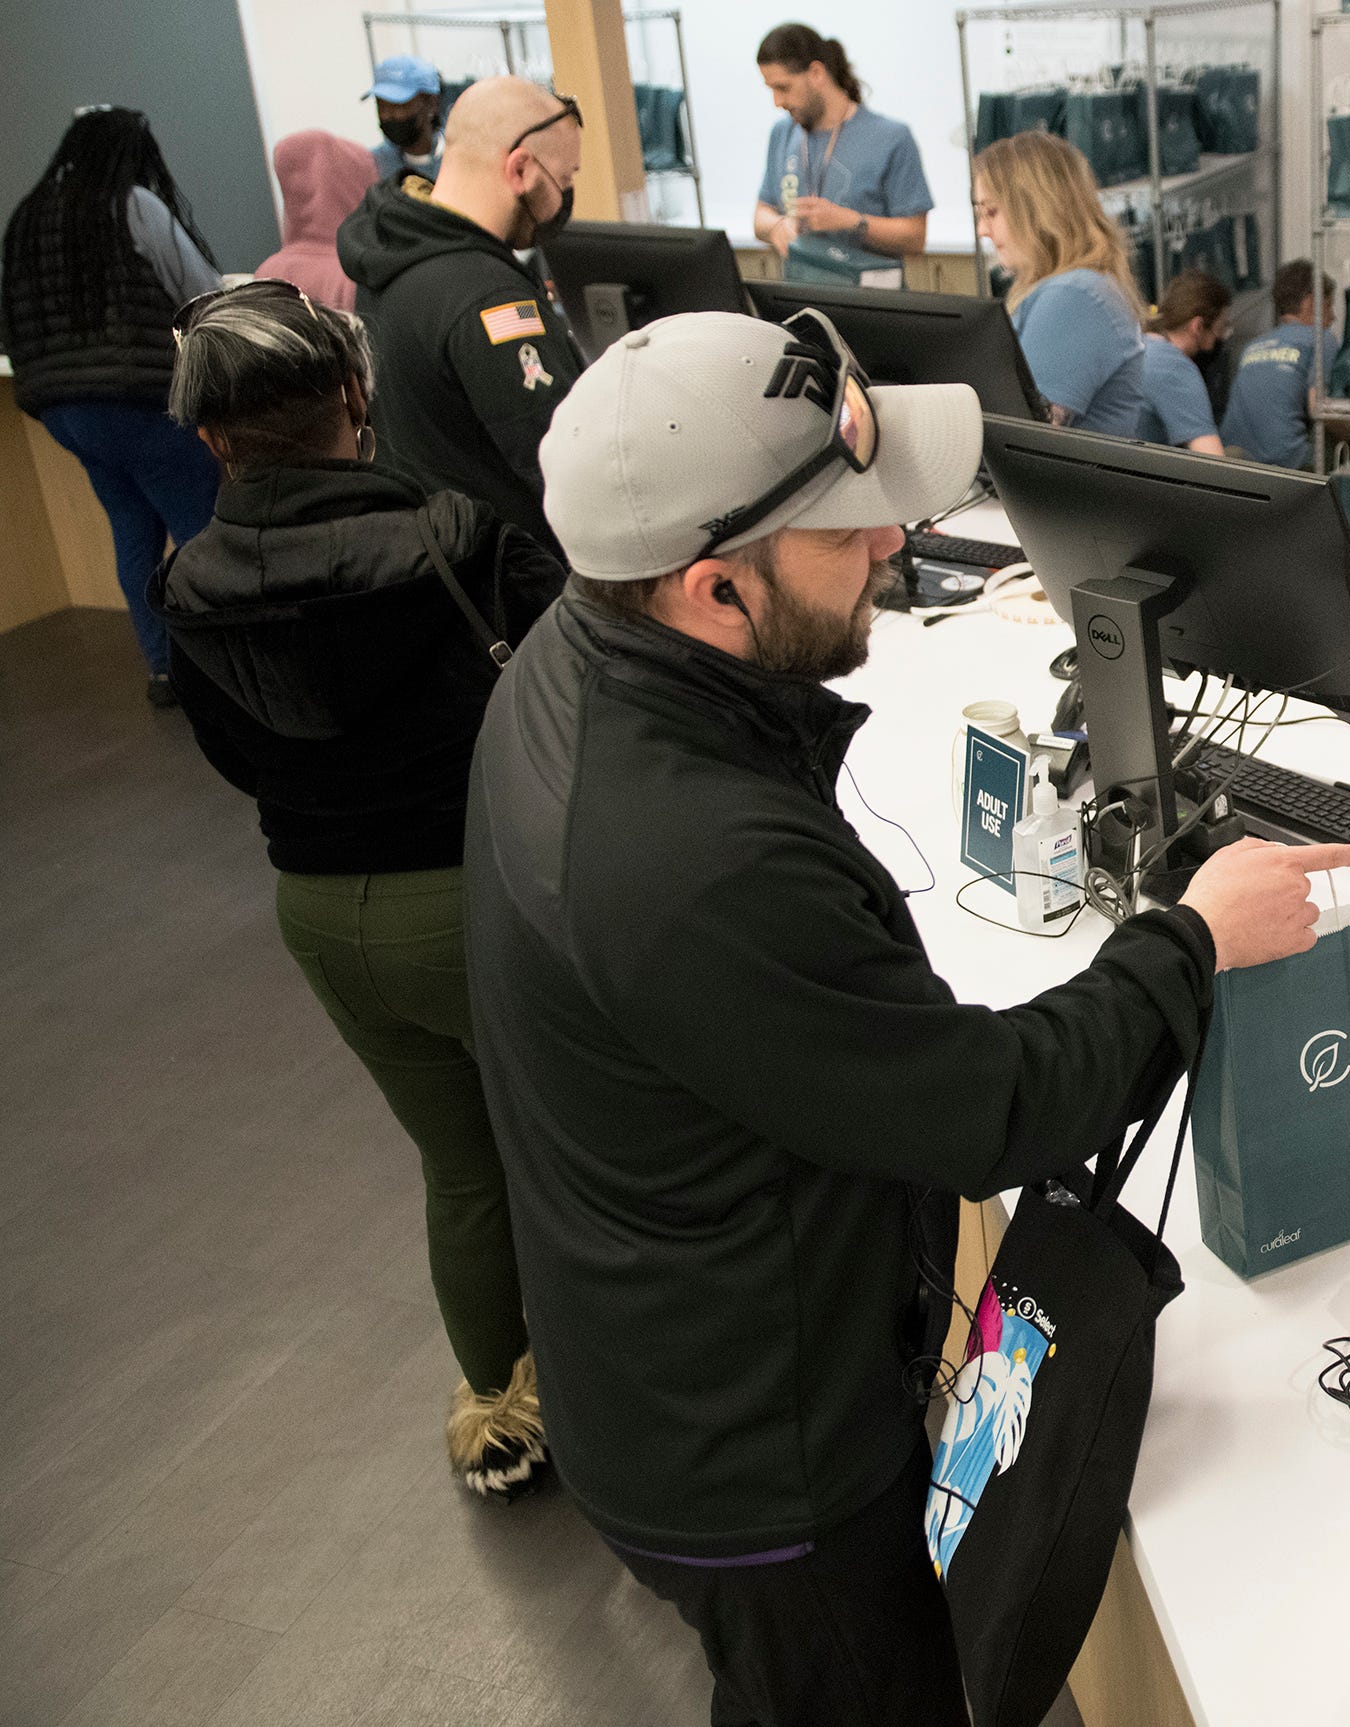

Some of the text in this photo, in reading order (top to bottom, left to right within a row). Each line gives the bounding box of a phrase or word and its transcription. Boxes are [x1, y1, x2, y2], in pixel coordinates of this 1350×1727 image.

[1091, 629, 1121, 646] DELL
[976, 788, 1009, 820] ADULT
[981, 811, 1002, 838] USE
[1260, 1227, 1302, 1254] curaleaf
[1034, 1308, 1057, 1338] Select
